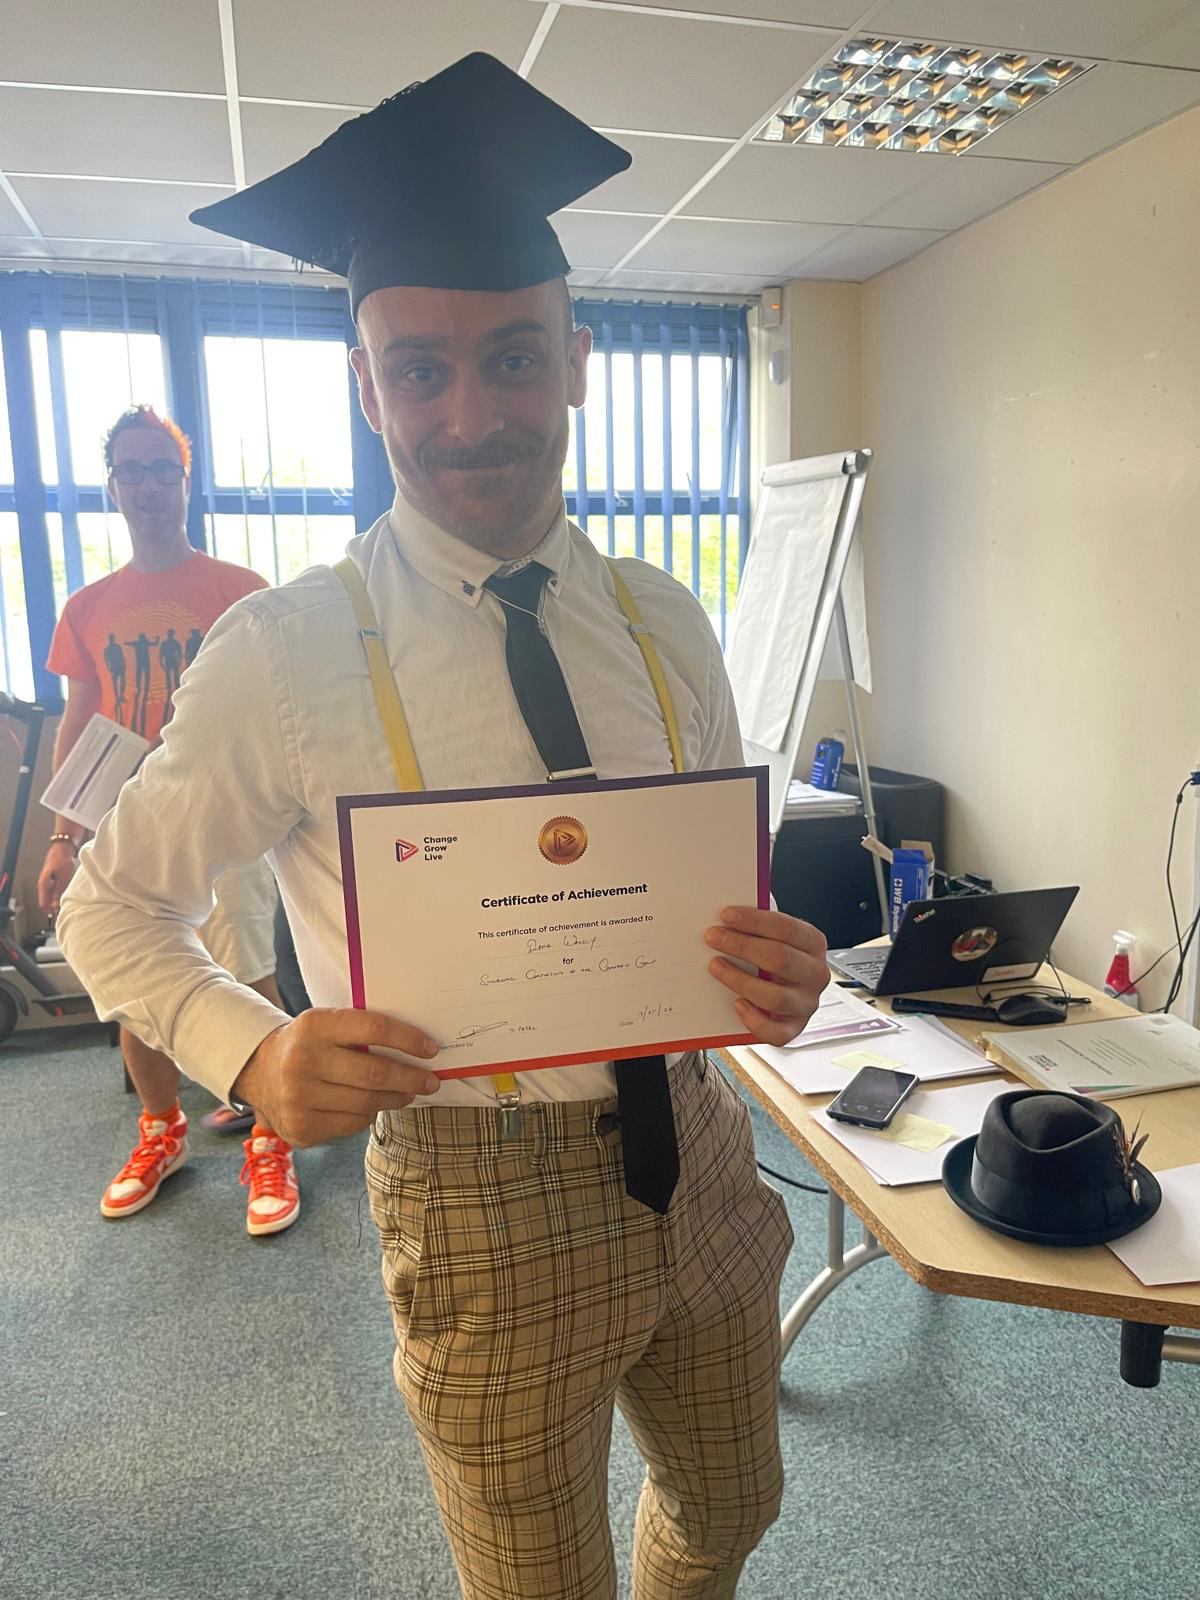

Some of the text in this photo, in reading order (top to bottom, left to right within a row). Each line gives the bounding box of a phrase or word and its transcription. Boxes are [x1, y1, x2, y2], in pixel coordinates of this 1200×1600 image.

[424, 836, 458, 844] Change
[424, 845, 448, 853] Grow
[424, 853, 443, 861] Live
[481, 883, 648, 908] Certificate of Achievement
[478, 931, 495, 939] This
[496, 928, 537, 938] certificate
[538, 925, 547, 933] of
[548, 920, 599, 932] achievement
[608, 916, 644, 926] awarded
[562, 957, 574, 965] for
